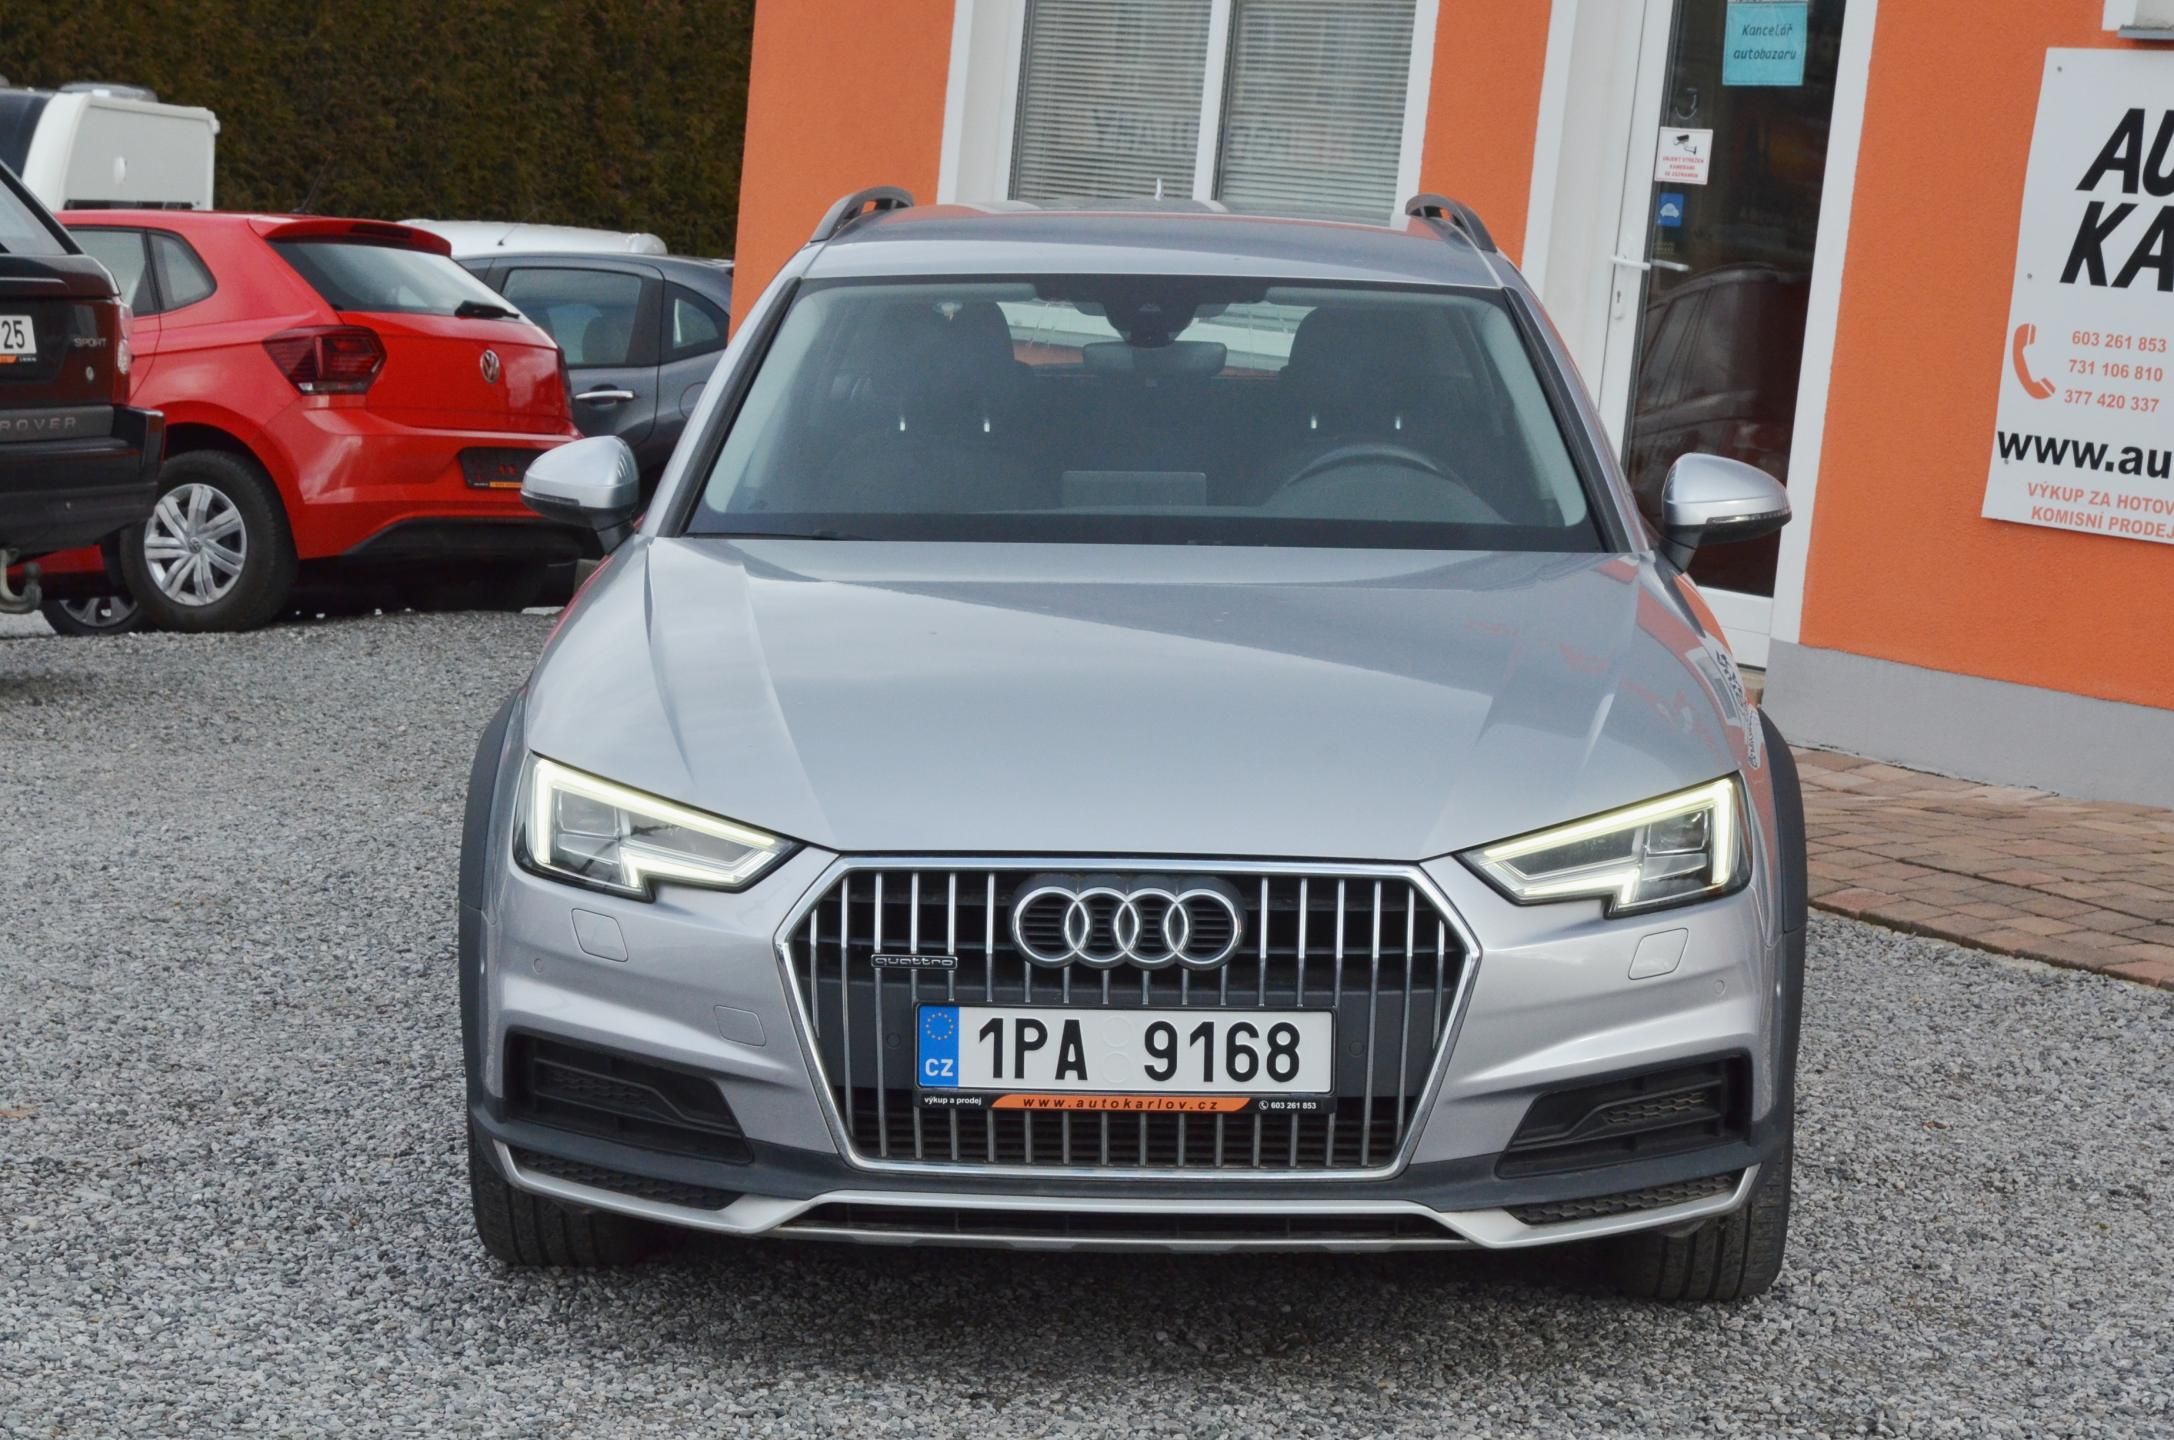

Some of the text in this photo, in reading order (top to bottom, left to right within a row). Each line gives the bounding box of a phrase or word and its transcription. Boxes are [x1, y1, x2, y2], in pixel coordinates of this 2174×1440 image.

[1742, 23, 1793, 36] Kancelář
[1733, 48, 1797, 60] autobazaru
[2059, 200, 2174, 292] KA
[1, 320, 26, 349] 25
[73, 337, 107, 347] SPORT
[2072, 330, 2167, 353] 603 261 853
[2069, 359, 2163, 382] 731 106 810
[2064, 389, 2160, 413] 377 420 337
[0, 417, 77, 431] ROVER
[1998, 431, 2172, 479] www.au
[2027, 481, 2085, 503] VÝKUP
[2088, 490, 2111, 508] ZA
[2031, 505, 2174, 540] KOMISNÍ PRODEJ
[875, 957, 954, 966] quattro
[979, 1017, 1301, 1083] 1PA 9168
[925, 1058, 954, 1078] CZ
[924, 1096, 948, 1105] výkup
[956, 1096, 982, 1105] prodej
[1023, 1097, 1218, 1110] www.autokarlov.cz
[1270, 1101, 1317, 1110] 603 261 853
